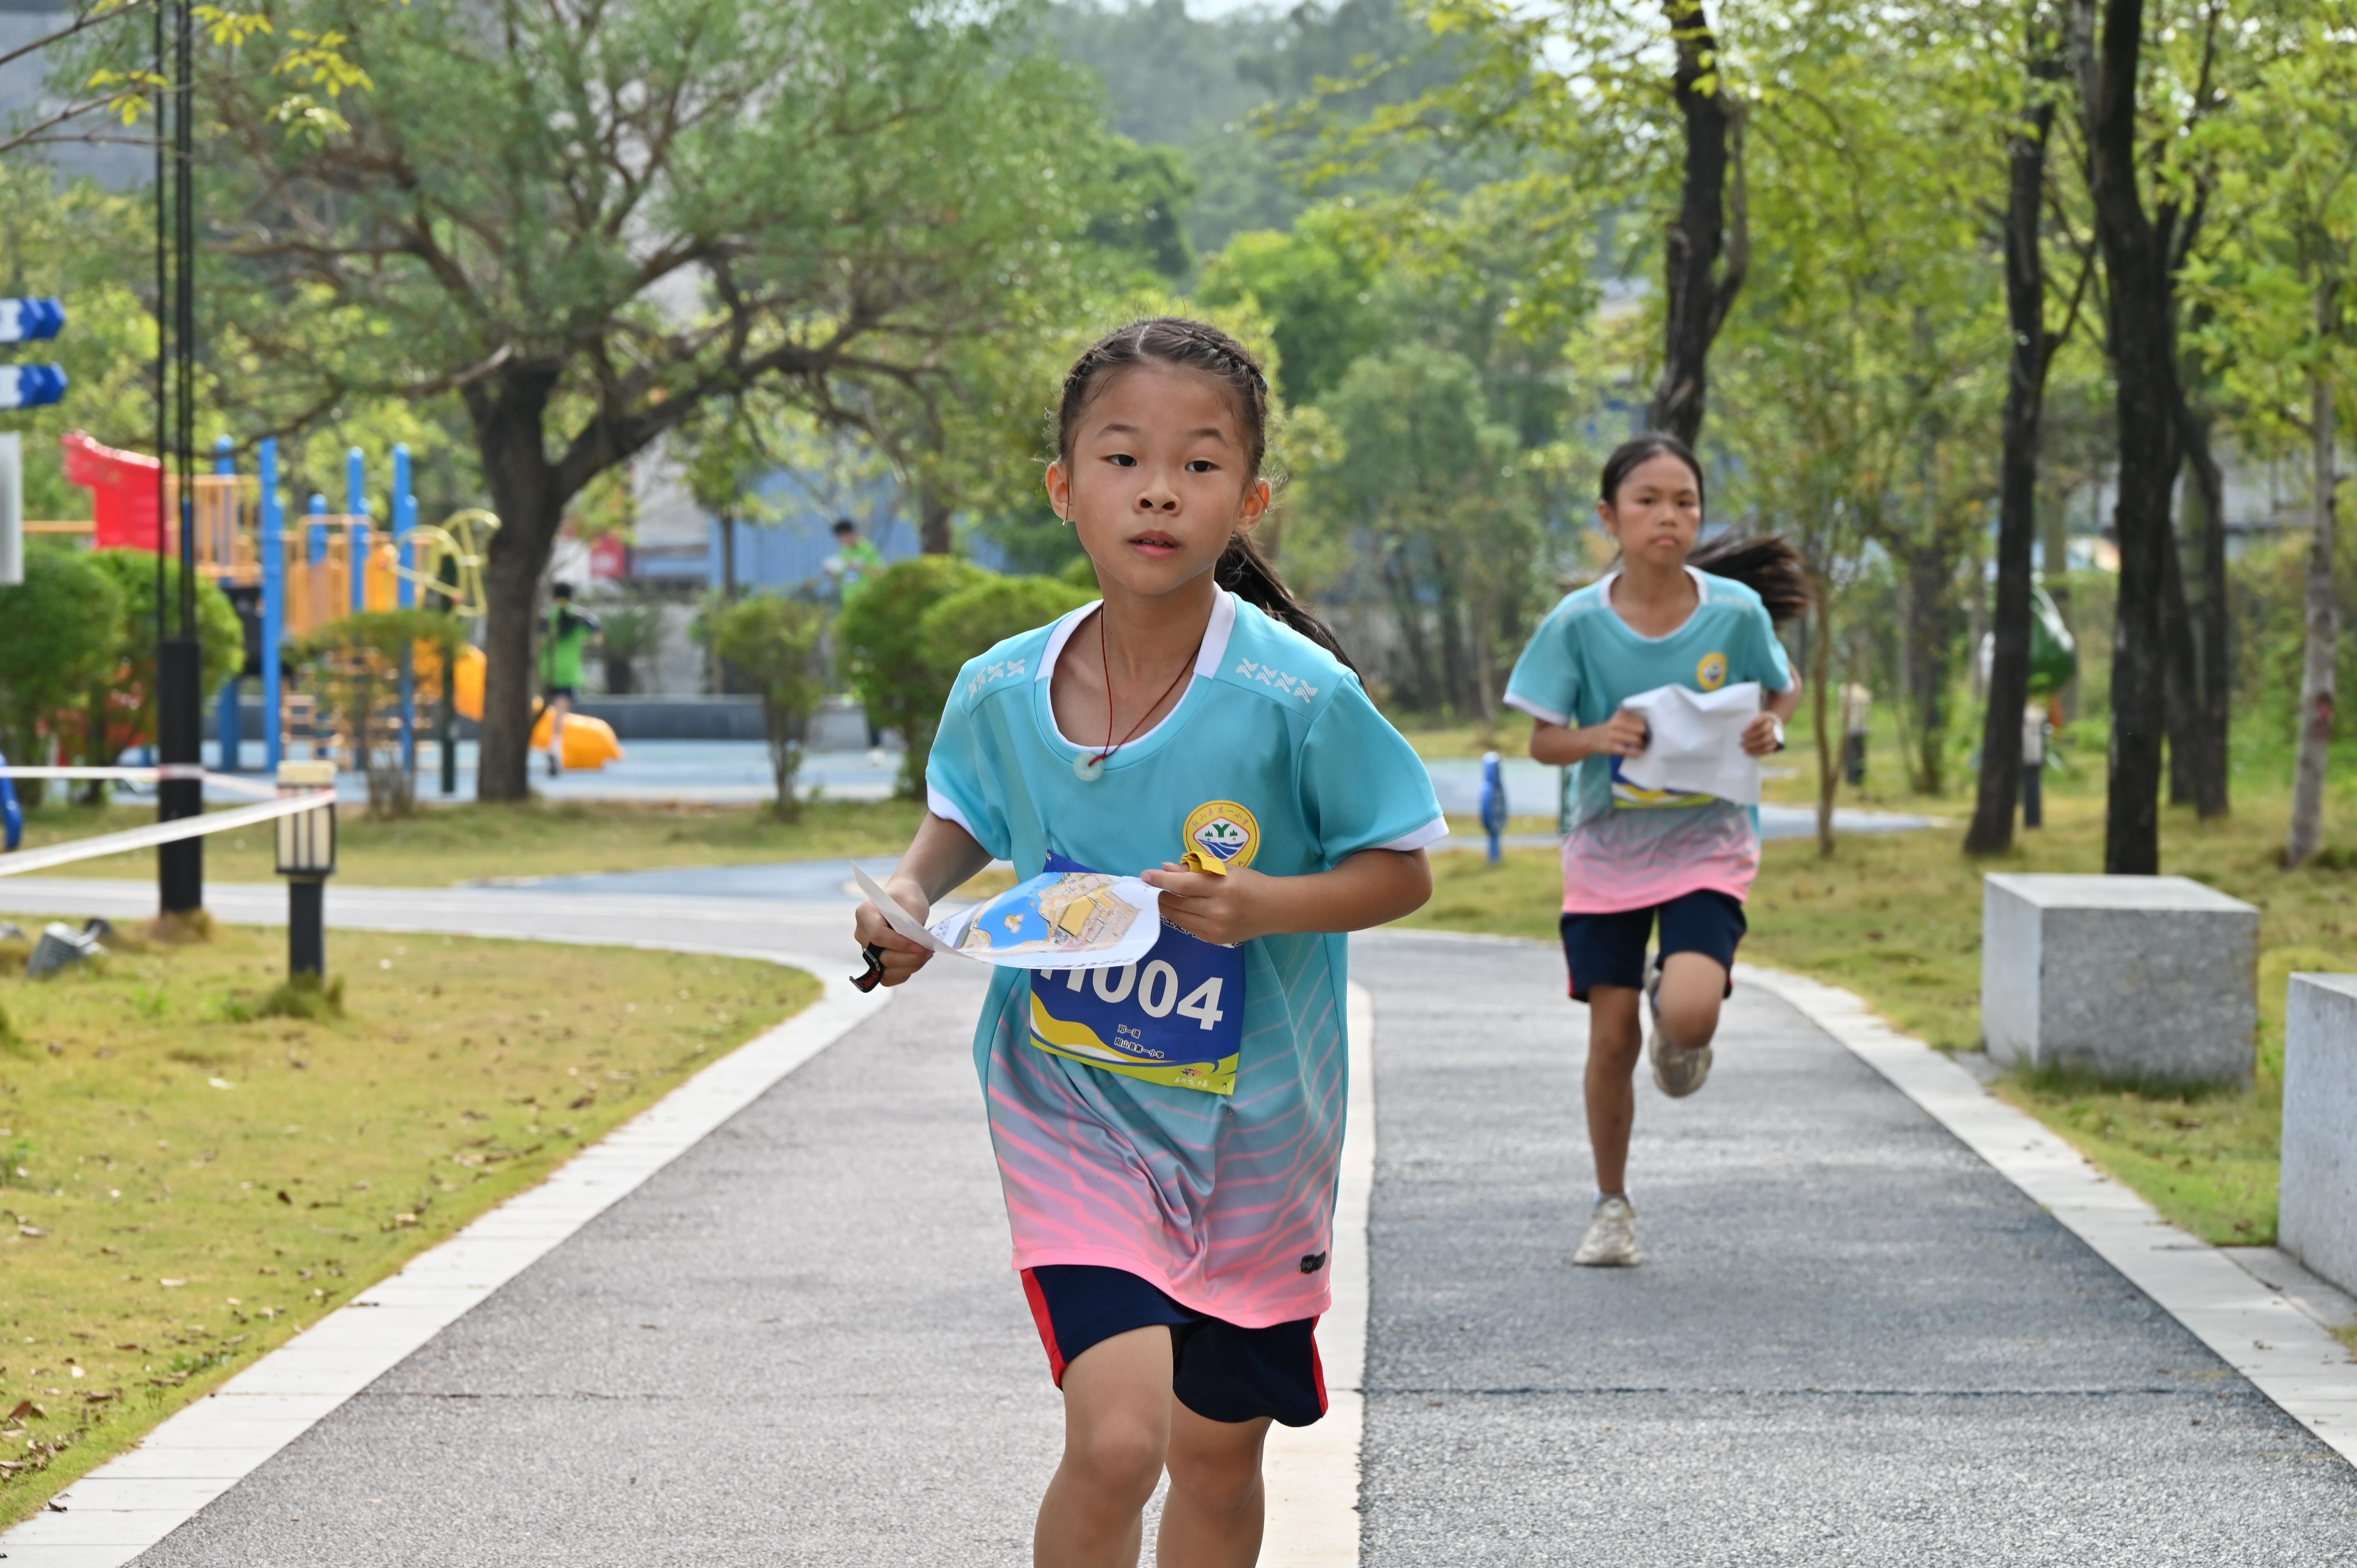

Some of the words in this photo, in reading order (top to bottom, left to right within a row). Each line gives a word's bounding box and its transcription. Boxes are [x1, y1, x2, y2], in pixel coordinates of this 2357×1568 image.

[1212, 824, 1230, 837] Y
[1114, 1037, 1164, 1059] 阳山县第一小学
